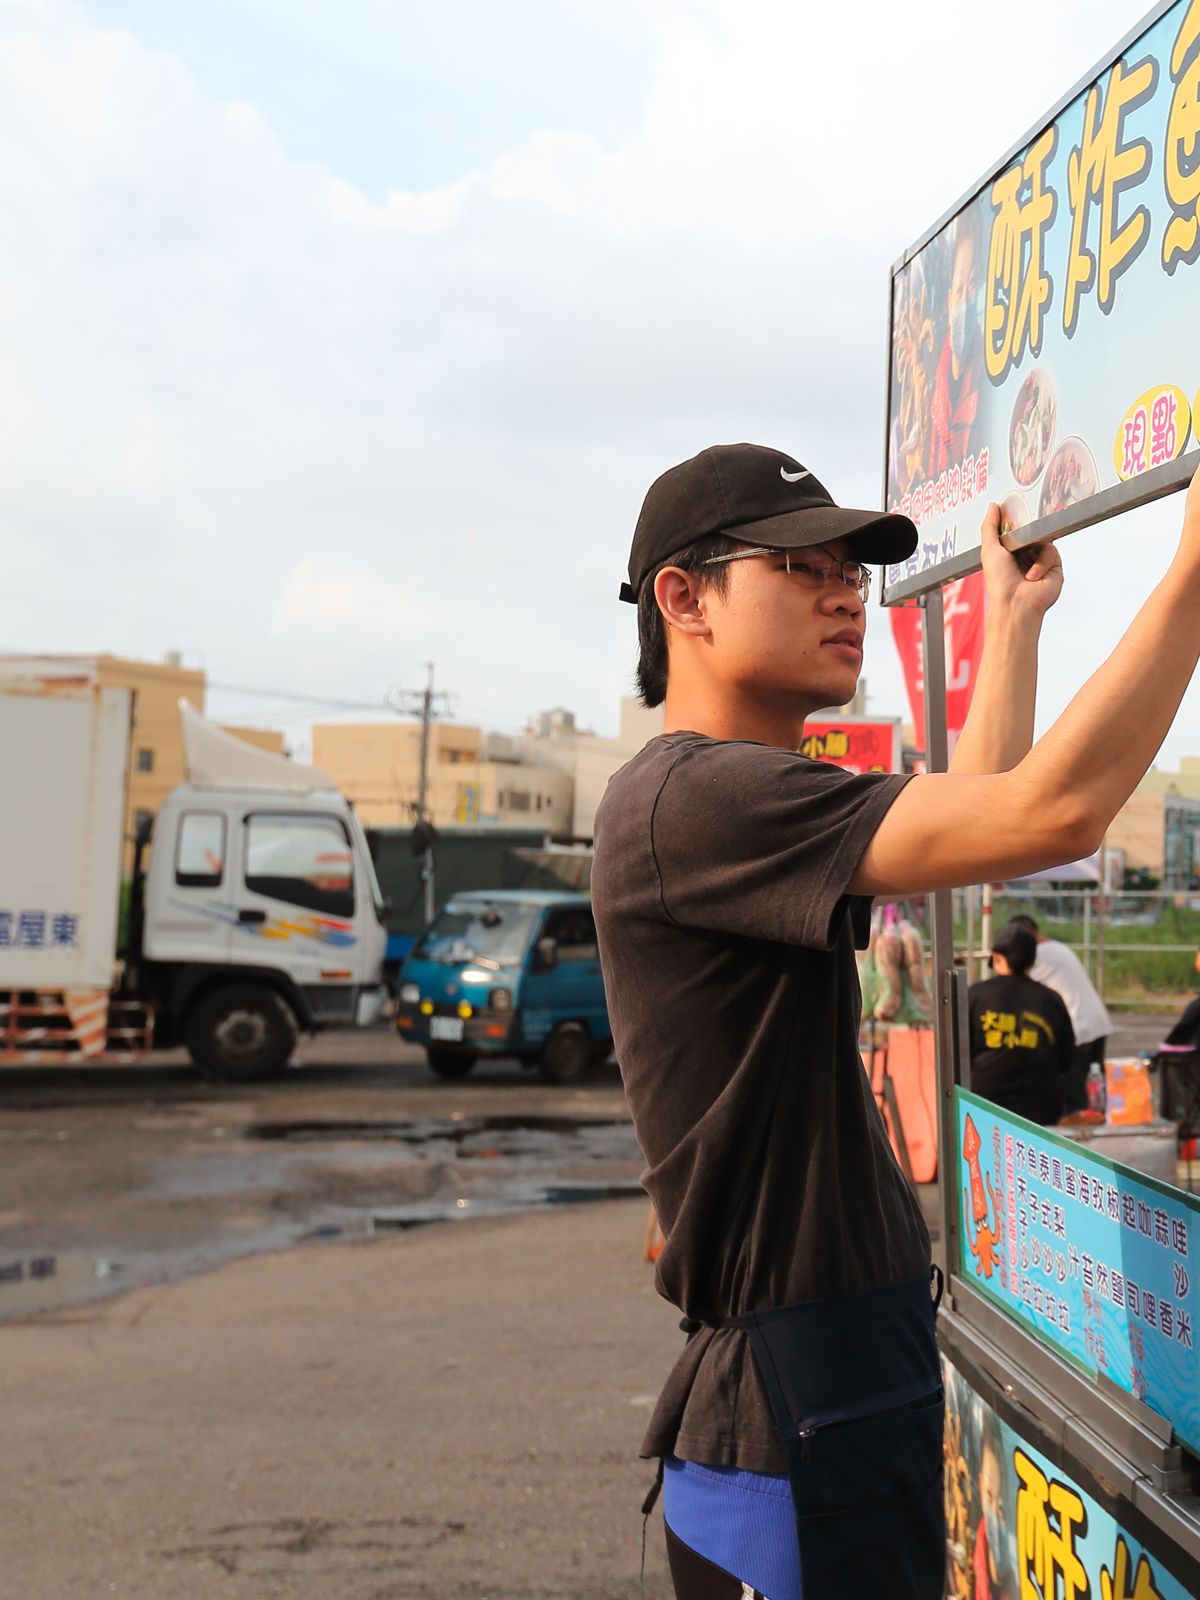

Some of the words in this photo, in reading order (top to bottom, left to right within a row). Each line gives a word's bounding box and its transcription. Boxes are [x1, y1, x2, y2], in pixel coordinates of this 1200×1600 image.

[1123, 391, 1176, 476] 現點
[1078, 1171, 1094, 1289] 海苔
[1122, 1193, 1140, 1318] 起司
[1138, 1201, 1157, 1329] 咖哩
[1172, 1219, 1192, 1348] 哇沙米
